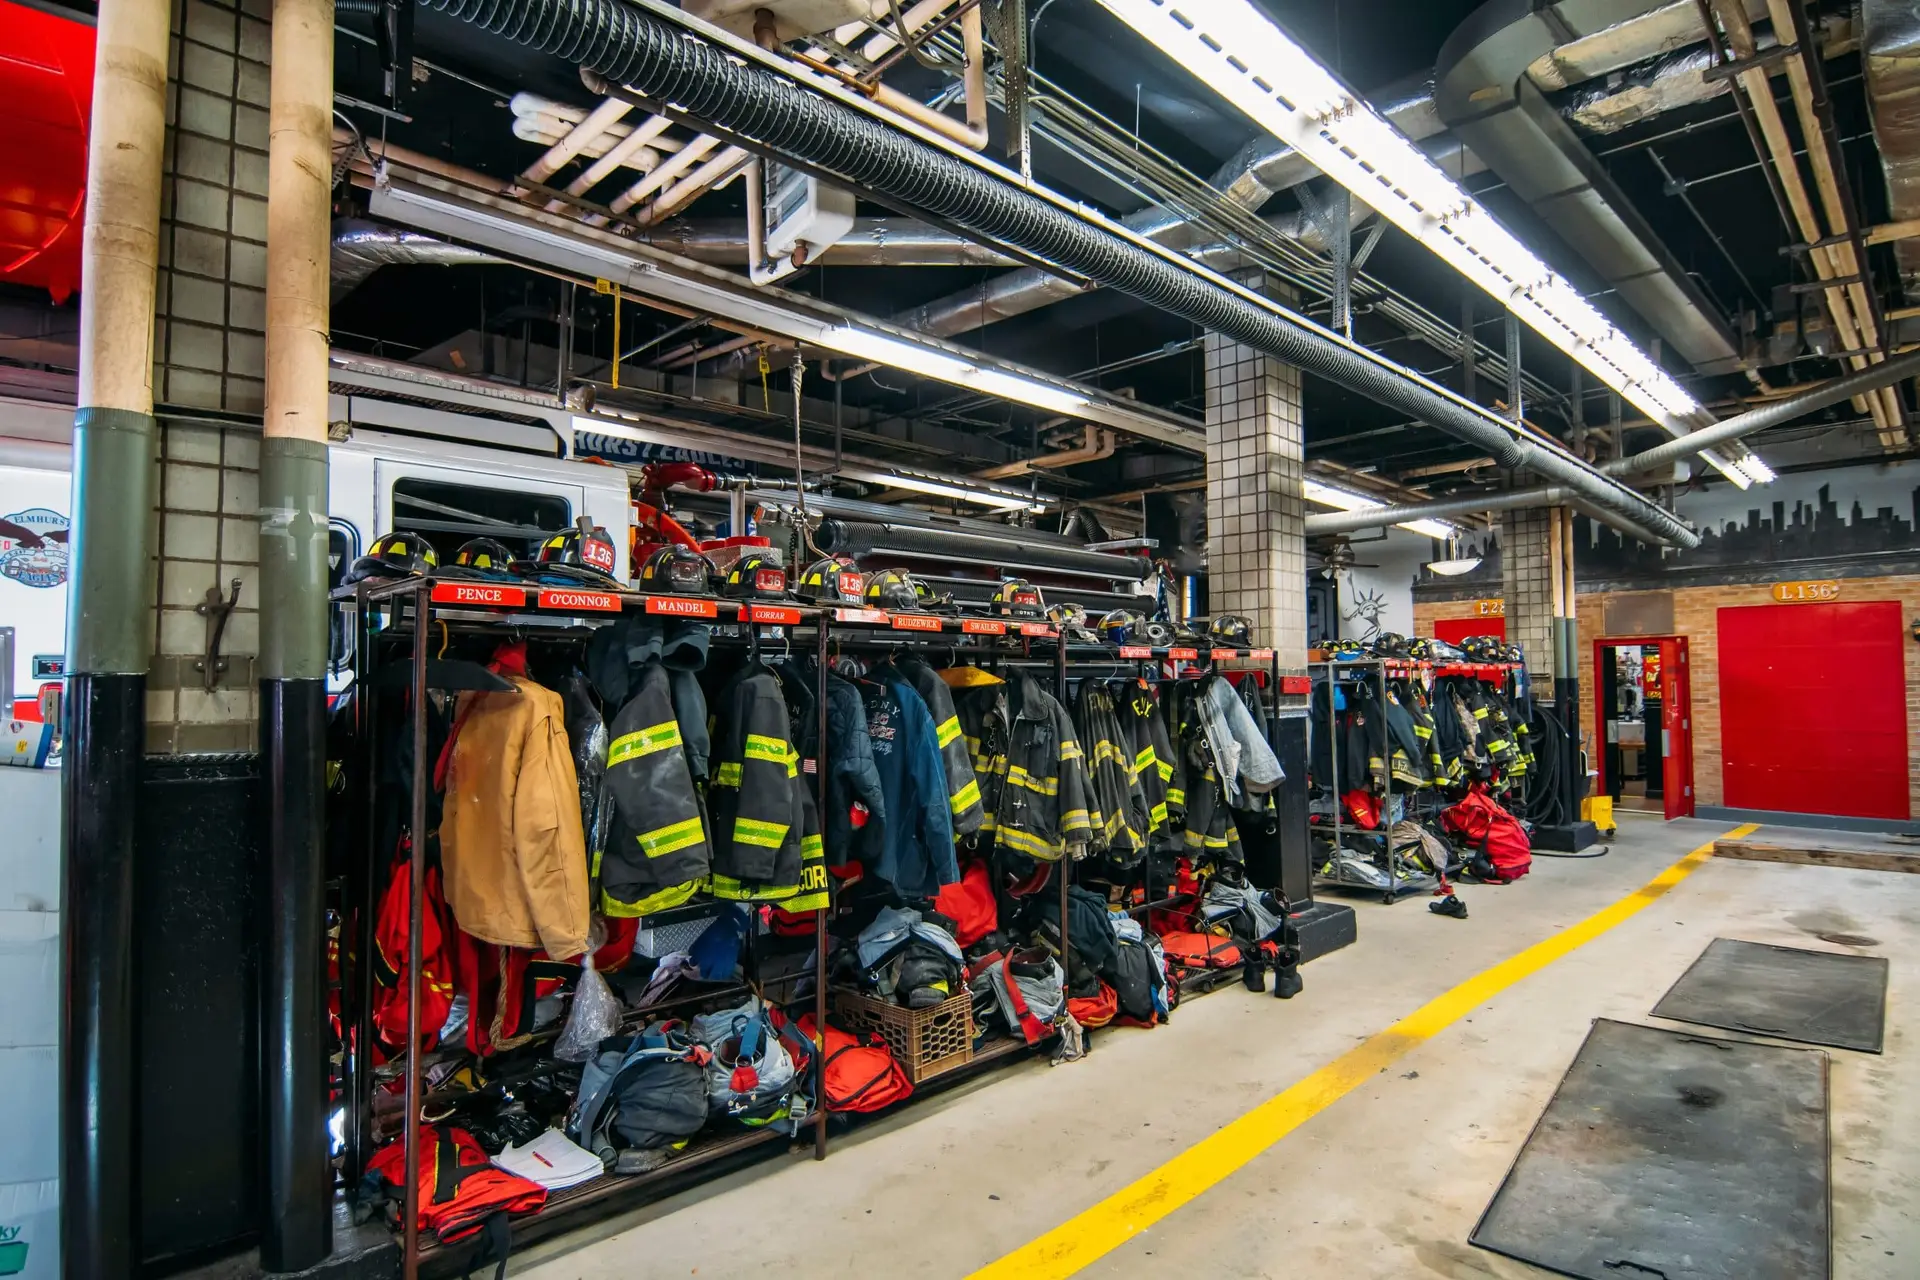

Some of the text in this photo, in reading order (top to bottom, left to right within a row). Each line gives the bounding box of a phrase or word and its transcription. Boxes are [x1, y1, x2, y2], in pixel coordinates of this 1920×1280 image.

[588, 544, 611, 565] 136
[760, 573, 781, 587] 136
[843, 577, 861, 592] 136
[457, 588, 502, 601] PENCE
[550, 594, 611, 608] O'CONNOR
[657, 600, 707, 613] MANDEL
[755, 610, 785, 620] CORRAR
[898, 617, 938, 629] RUDZEWICK
[970, 623, 999, 632] SWAILES
[799, 865, 828, 892] COR
